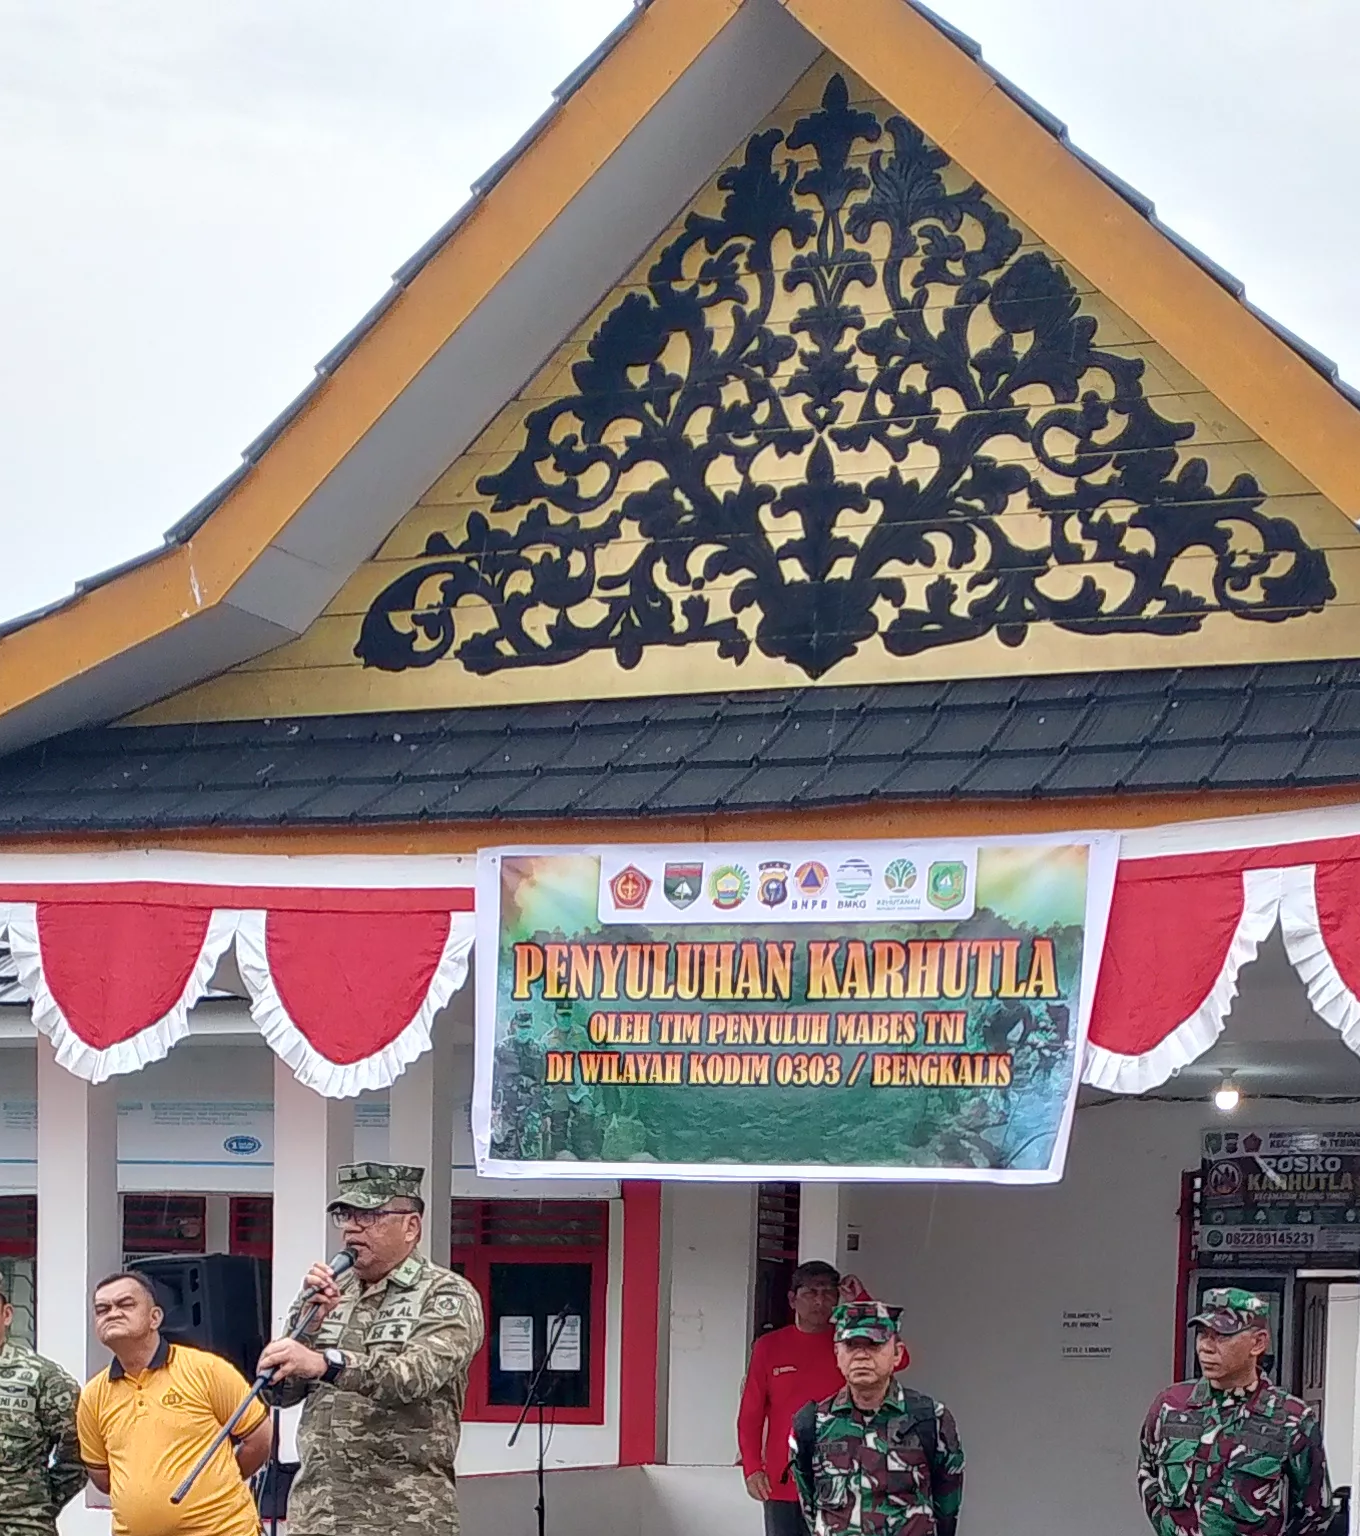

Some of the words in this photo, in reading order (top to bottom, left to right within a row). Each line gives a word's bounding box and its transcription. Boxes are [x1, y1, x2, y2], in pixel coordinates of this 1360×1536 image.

[511, 941, 795, 1000] PENYULUHAN
[806, 939, 1059, 999] KARHUTLA
[589, 1011, 652, 1044] OLEH
[657, 1011, 702, 1044] TIM
[706, 1011, 830, 1045] PENYULUH
[835, 1011, 917, 1045] MABES
[923, 1011, 967, 1045] TNI
[545, 1052, 575, 1085] DI
[578, 1052, 684, 1085] WILAYAH
[687, 1052, 772, 1086] KODIM
[775, 1053, 841, 1087] 0303
[845, 1053, 867, 1087] /
[870, 1053, 1013, 1087] BENGKALIS
[13, 1399, 28, 1408] AD
